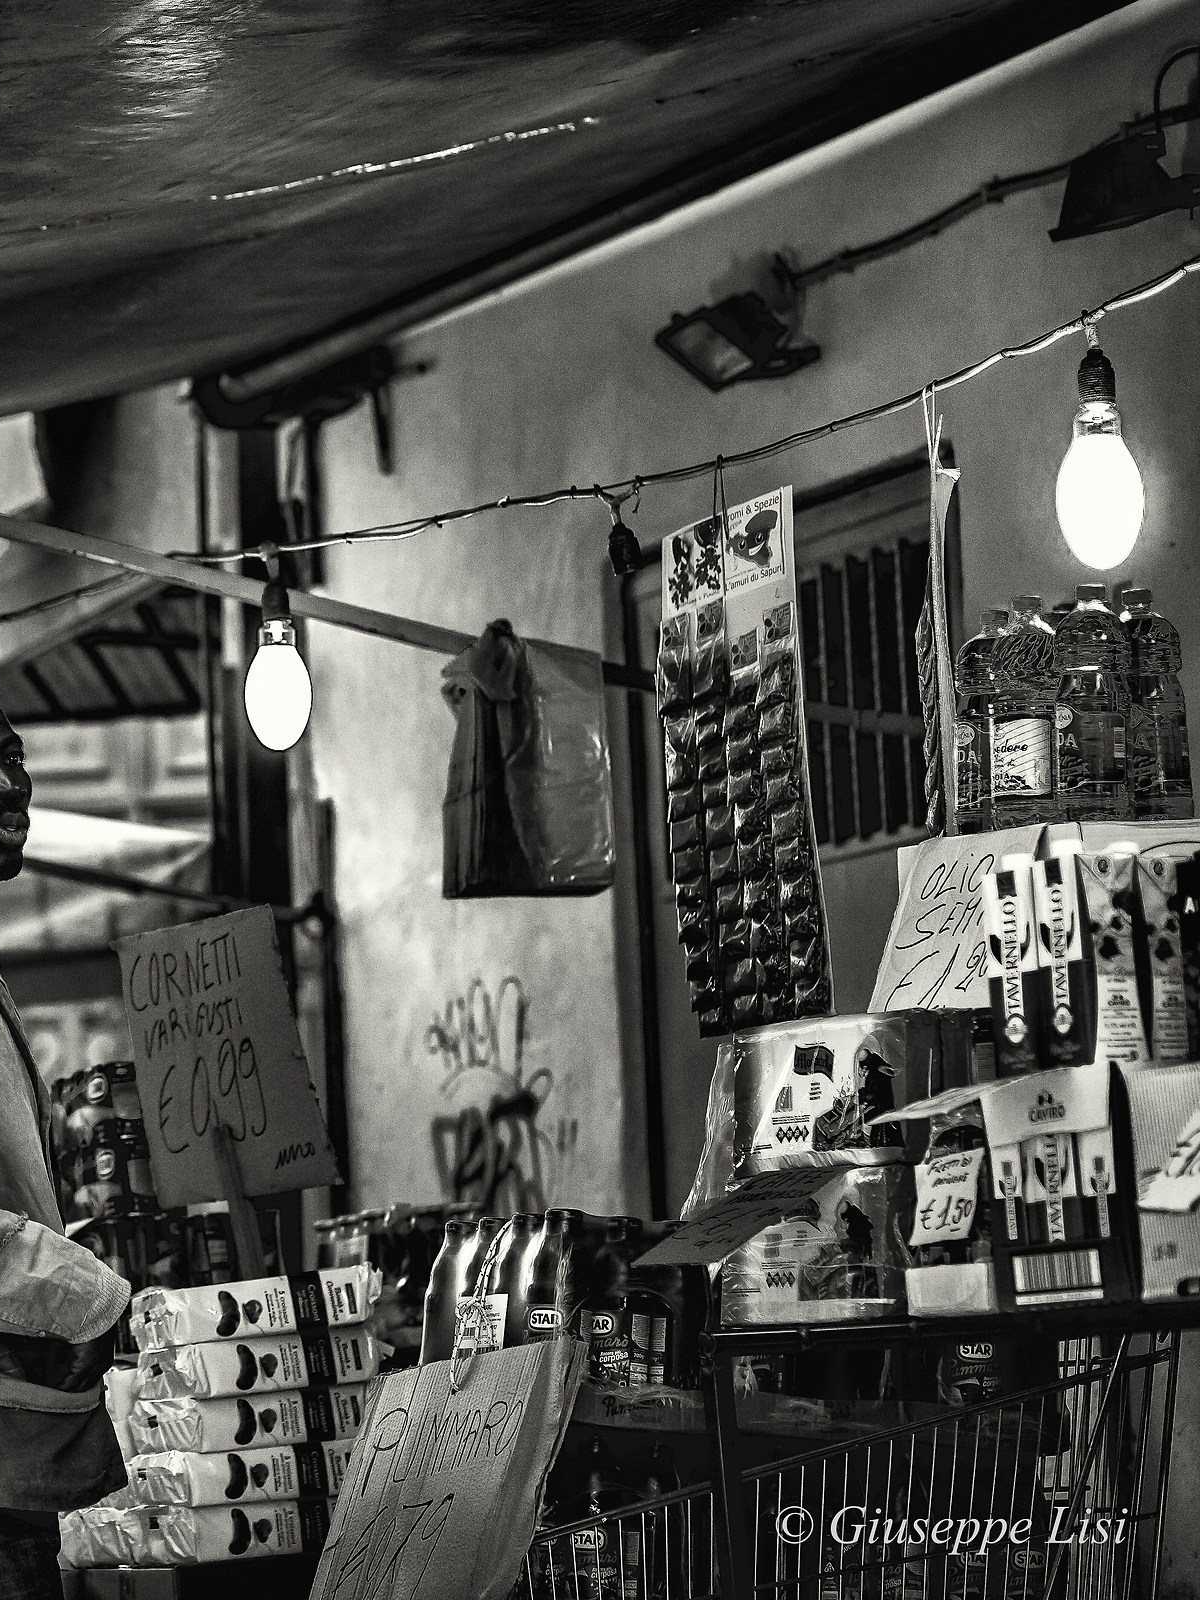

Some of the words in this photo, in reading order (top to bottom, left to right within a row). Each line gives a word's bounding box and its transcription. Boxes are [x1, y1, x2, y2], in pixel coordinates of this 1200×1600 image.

[726, 509, 745, 522] romi
[745, 504, 752, 515] &
[754, 495, 780, 513] Spezie
[750, 572, 759, 583] du
[1003, 901, 1022, 1016] TAVERNELLO
[1051, 889, 1068, 1005] TAVERNELLO
[130, 927, 241, 1012] CORNETTI
[196, 997, 243, 1038] GUSTI
[1028, 1104, 1066, 1123] CAVIRO
[307, 1284, 320, 1321] Croissant
[599, 1351, 629, 1363] corposa
[962, 1343, 991, 1356] STAR
